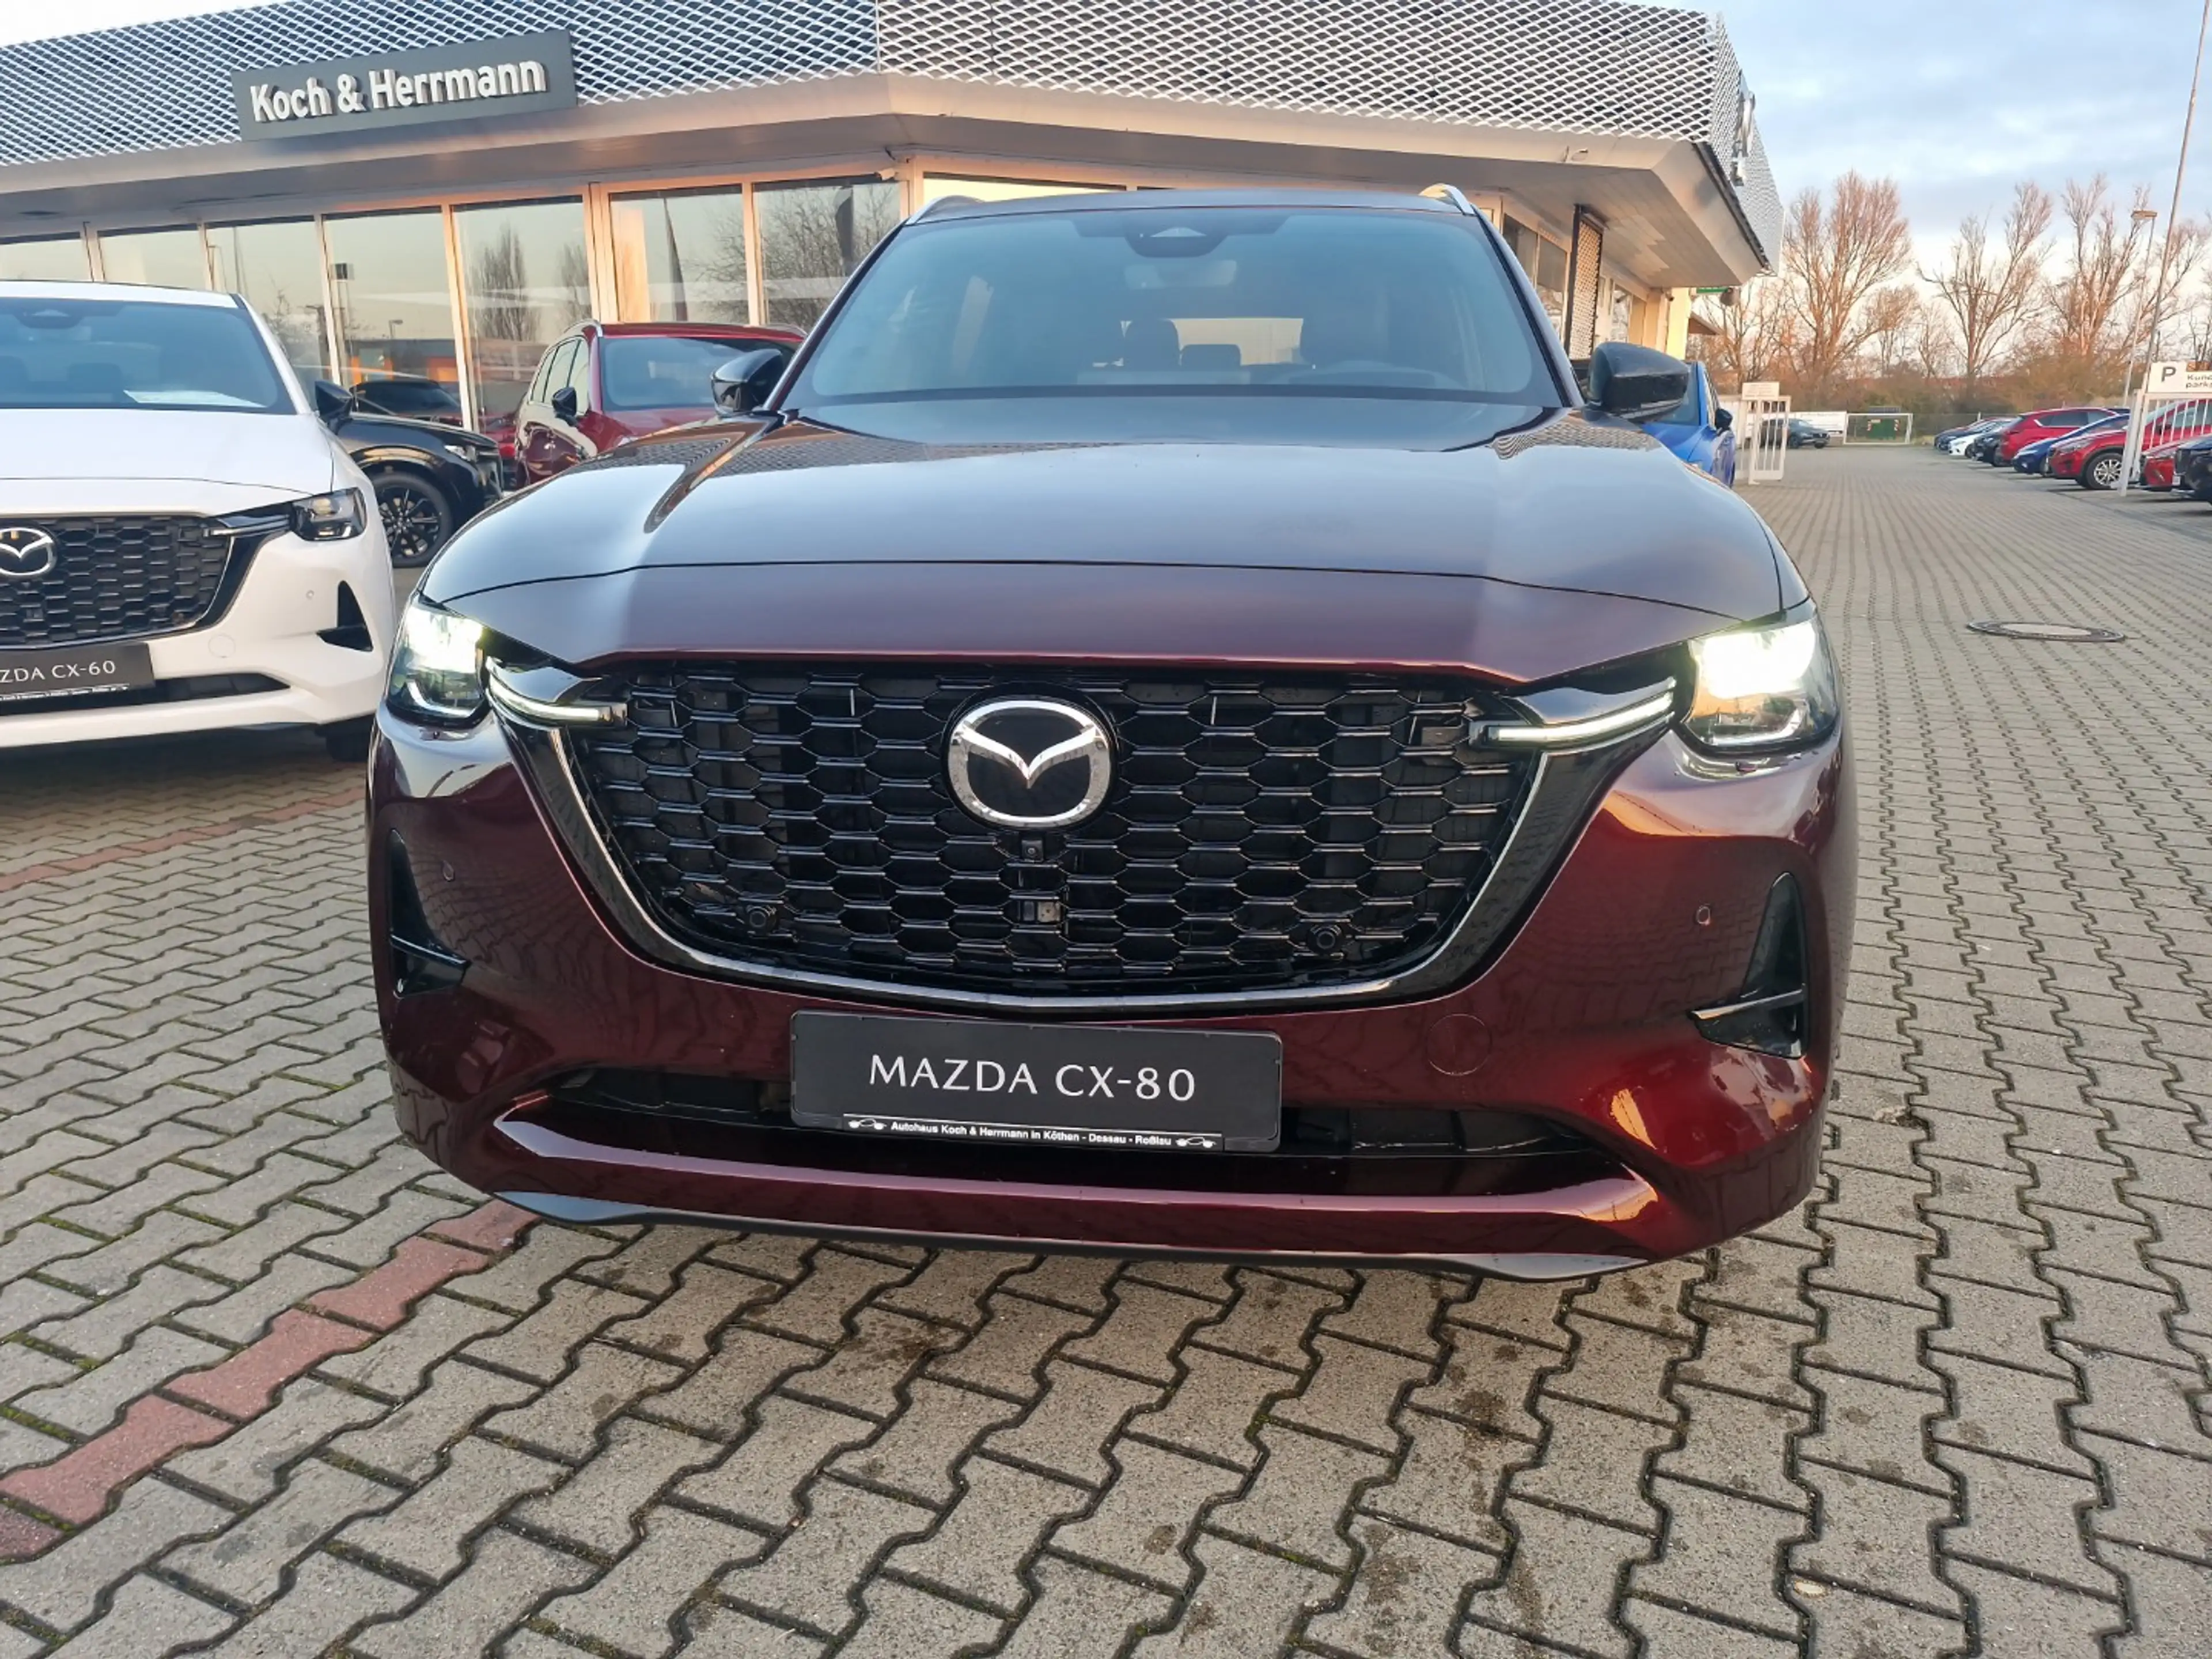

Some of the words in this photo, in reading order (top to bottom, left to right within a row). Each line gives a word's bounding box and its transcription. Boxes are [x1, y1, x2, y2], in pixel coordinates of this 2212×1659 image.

[250, 77, 332, 122] Koch
[337, 73, 367, 113] &
[368, 60, 547, 109] Herrmann
[2161, 366, 2176, 382] P
[51, 660, 116, 679] CX-60
[870, 1054, 1037, 1094] MAZDA
[1055, 1064, 1195, 1101] CX-80
[891, 1122, 938, 1133] Autohaus
[941, 1124, 967, 1135] Koch
[969, 1126, 977, 1136] &
[979, 1127, 1028, 1139] Herrmann
[1031, 1130, 1041, 1139] in
[1043, 1130, 1080, 1142] Köthen
[1089, 1133, 1126, 1144] Dessau
[1135, 1135, 1172, 1146] Roßlau
